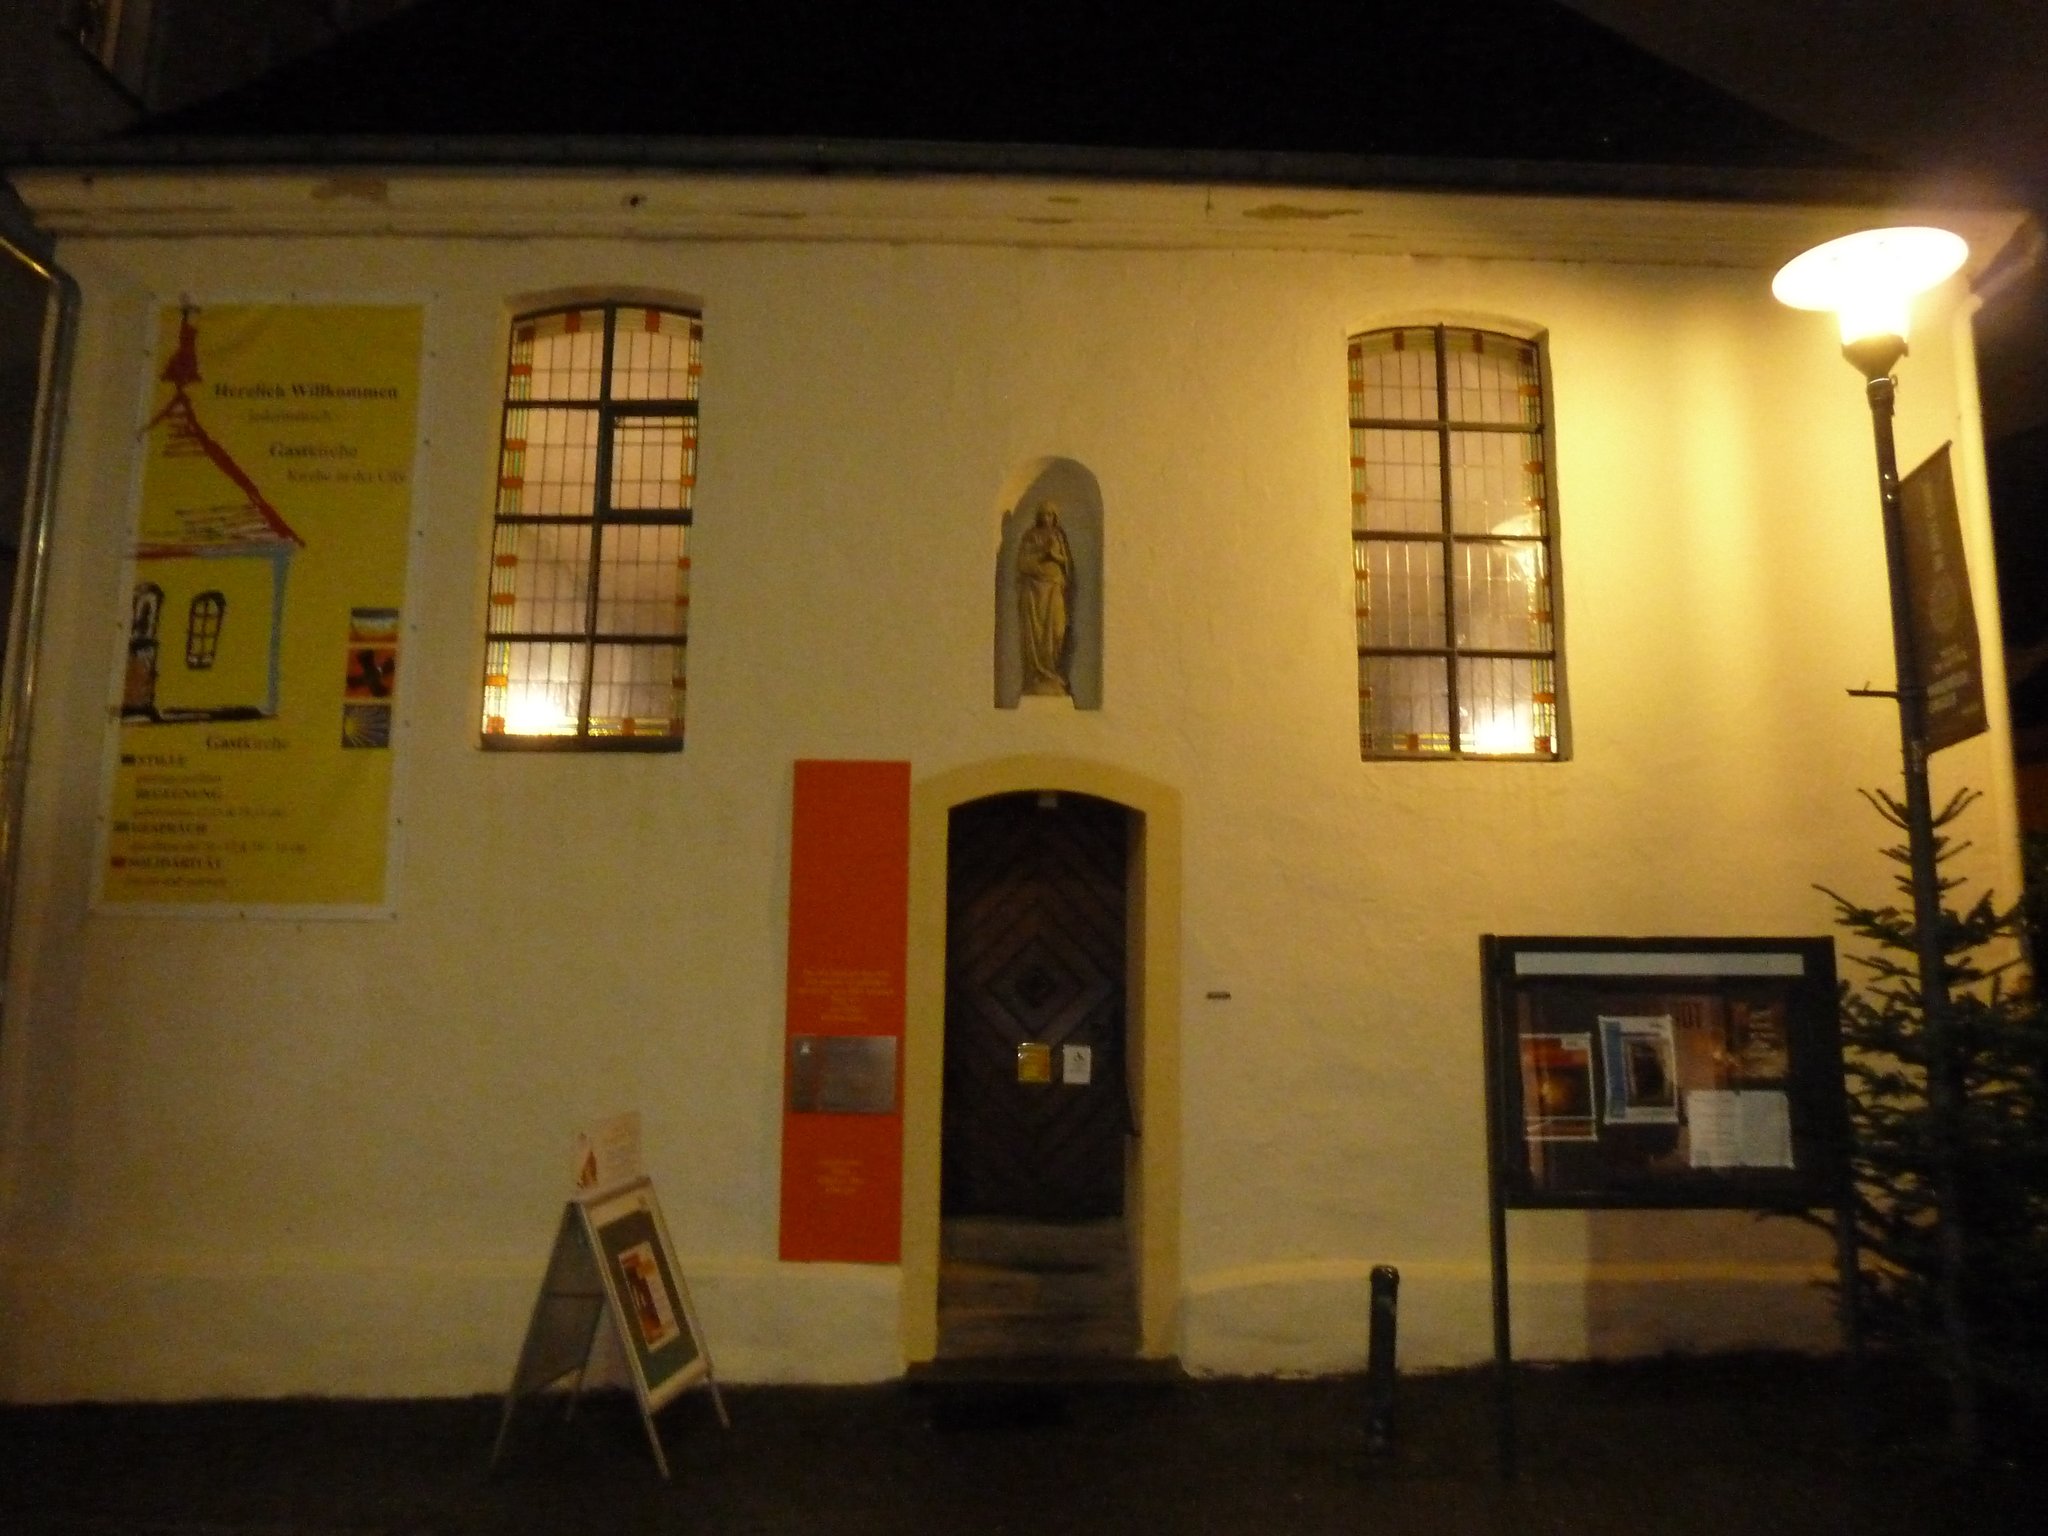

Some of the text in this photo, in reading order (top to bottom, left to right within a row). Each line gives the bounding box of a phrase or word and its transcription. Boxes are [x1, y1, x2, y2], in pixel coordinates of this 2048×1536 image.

[214, 382, 398, 400] Herzlich Willkommen
[269, 441, 358, 459] Gastkirche
[206, 736, 289, 752] Gastkirche
